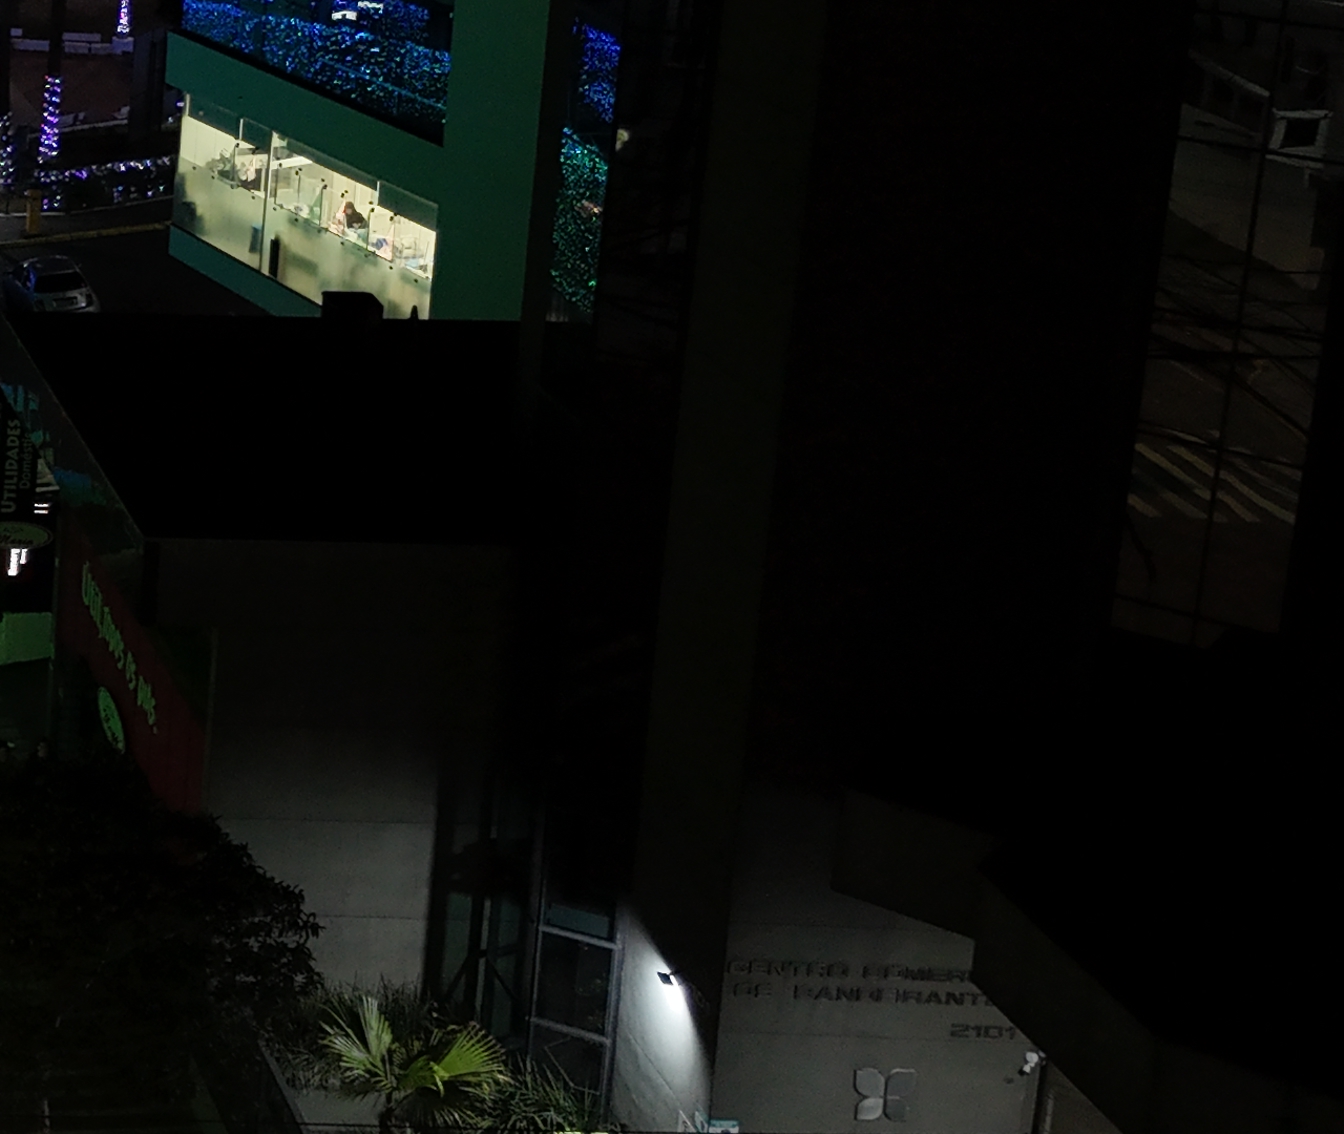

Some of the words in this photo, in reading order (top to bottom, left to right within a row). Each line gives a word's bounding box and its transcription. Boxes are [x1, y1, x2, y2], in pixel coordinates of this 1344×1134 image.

[0, 418, 21, 514] UTILIDADES
[862, 964, 972, 983] COMER
[949, 1022, 1016, 1040] 2101
